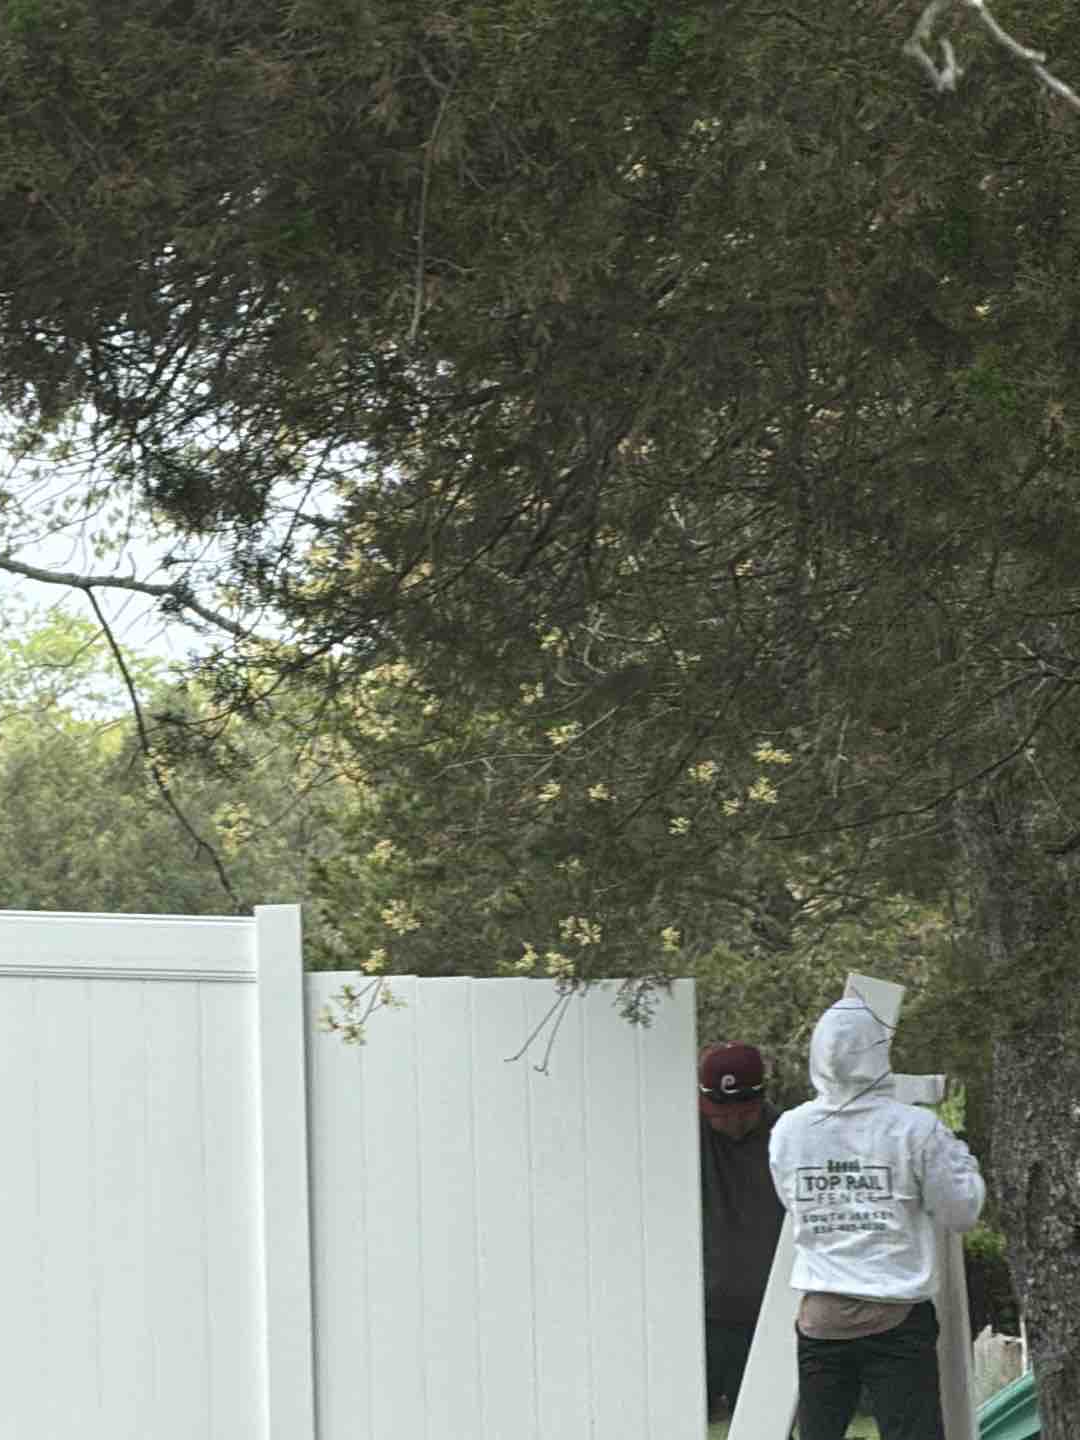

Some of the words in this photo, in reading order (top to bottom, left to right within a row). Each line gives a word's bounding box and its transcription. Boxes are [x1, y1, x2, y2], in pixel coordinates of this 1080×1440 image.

[803, 1175, 841, 1192] TOP
[845, 1175, 883, 1191] RAIL
[816, 1192, 878, 1205] FENCE
[802, 1211, 846, 1223] SOUTH
